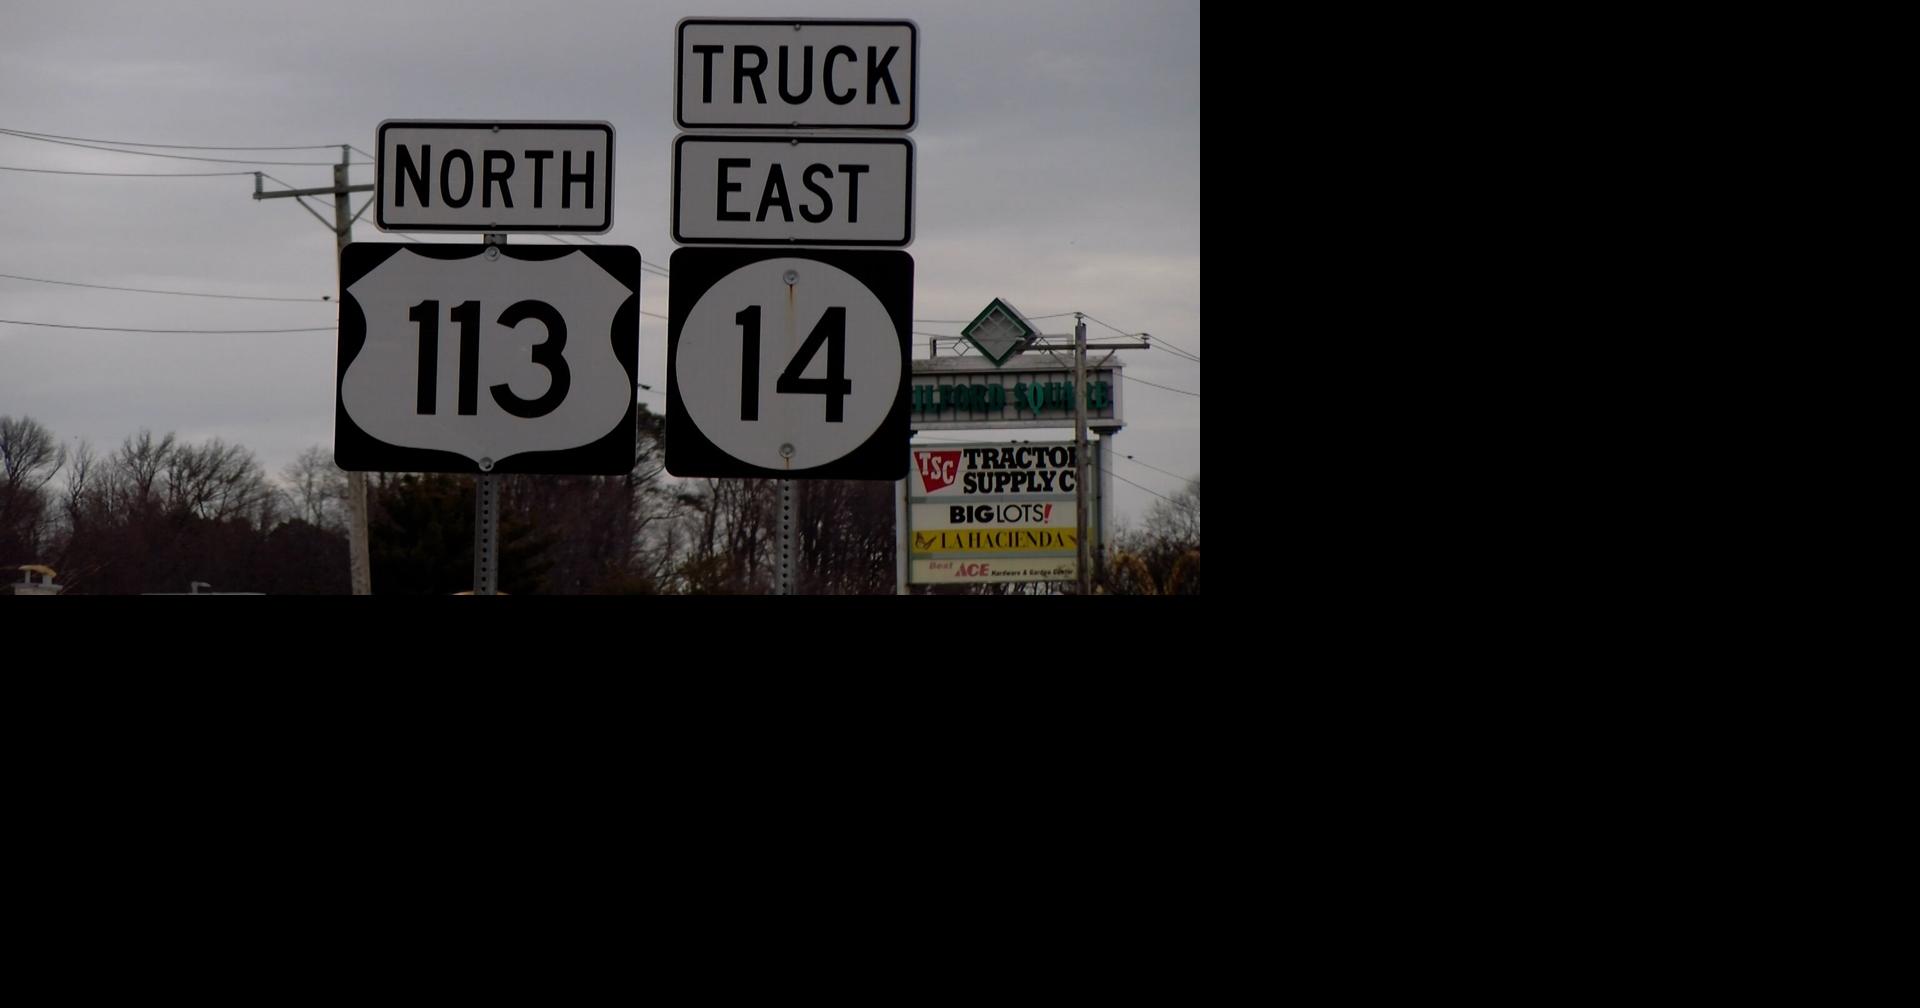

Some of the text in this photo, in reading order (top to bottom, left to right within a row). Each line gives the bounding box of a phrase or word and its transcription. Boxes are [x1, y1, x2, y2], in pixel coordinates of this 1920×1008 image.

[692, 45, 901, 105] TRUCK
[395, 144, 595, 209] NORTH
[716, 158, 870, 223] EAST
[408, 299, 571, 419] 113
[735, 305, 852, 423] 14
[912, 383, 1006, 412] ILFORD
[919, 452, 954, 485] TSC
[963, 470, 1057, 494] SUPPLY
[941, 531, 1065, 549] LA HACIENDA
[954, 563, 990, 577] ACE
